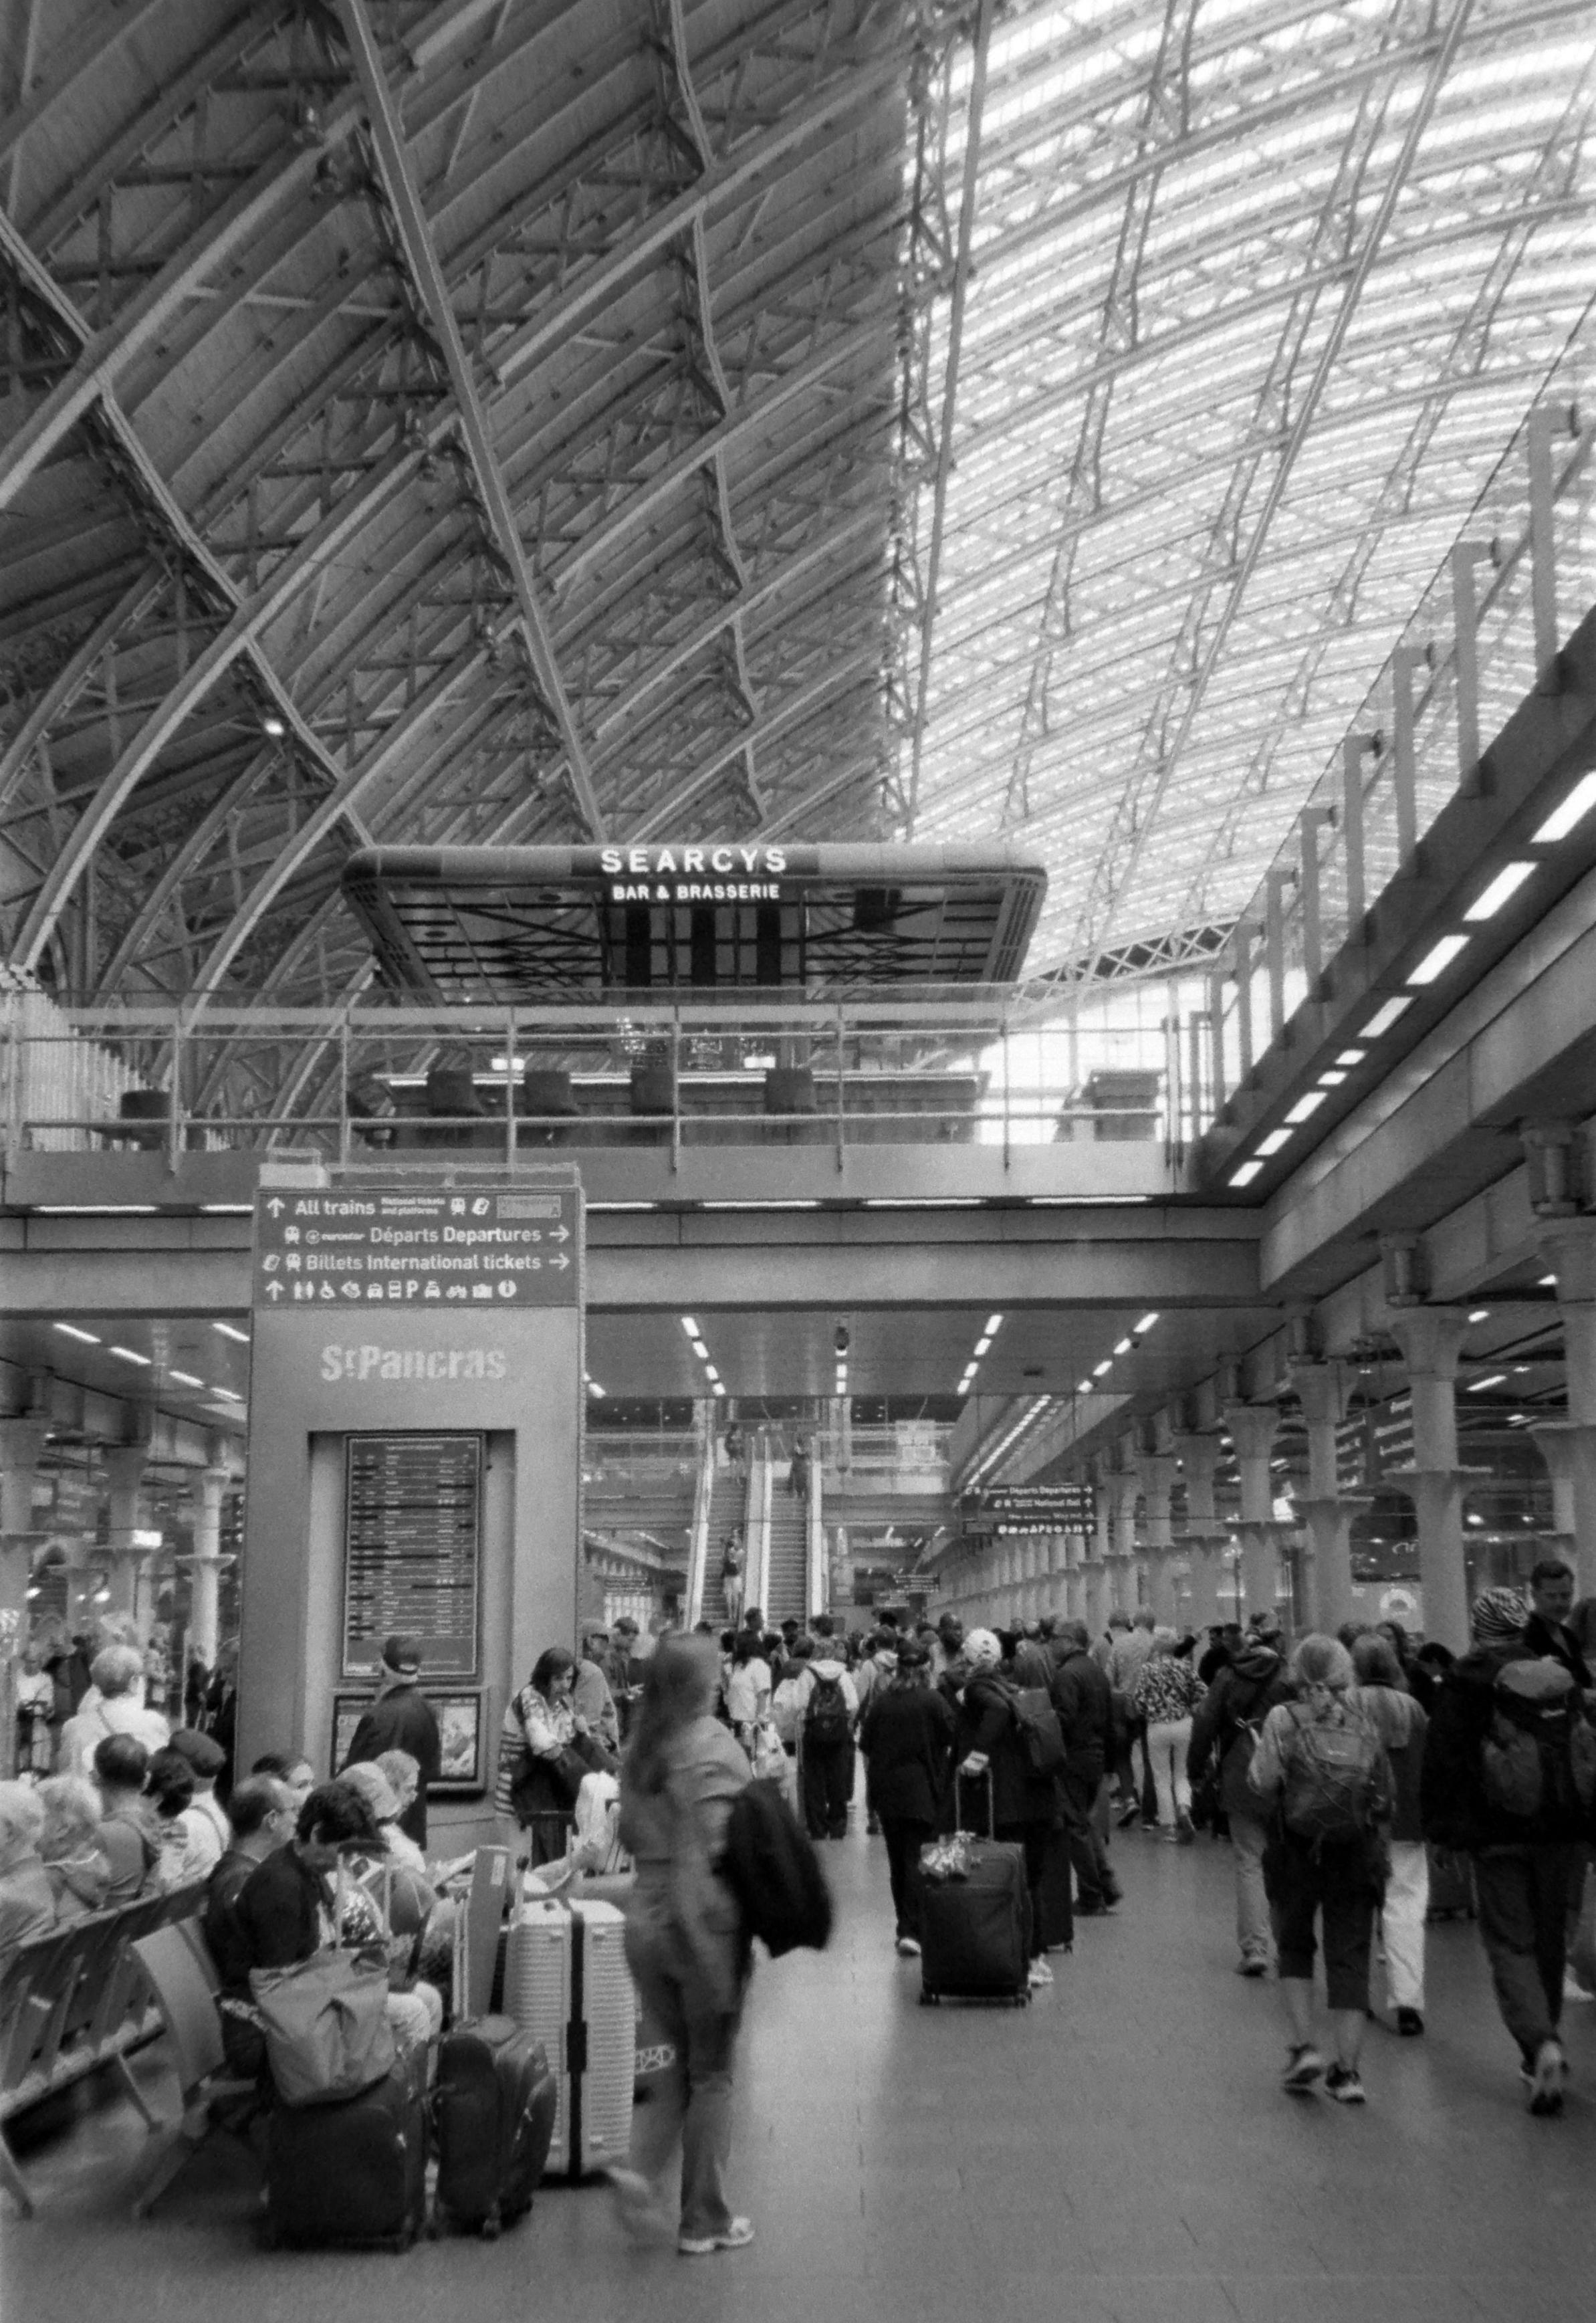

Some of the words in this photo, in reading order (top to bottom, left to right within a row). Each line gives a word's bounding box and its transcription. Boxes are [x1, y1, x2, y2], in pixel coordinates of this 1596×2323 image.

[601, 848, 787, 873] SEARCYS
[612, 885, 649, 900] BAR
[657, 885, 670, 899] &
[677, 883, 780, 899] BRASSERIE
[295, 1200, 320, 1215] All
[323, 1200, 376, 1215] trains
[370, 1226, 439, 1246] Départs
[443, 1226, 542, 1246] Departures
[306, 1255, 363, 1270] Billets
[367, 1254, 479, 1270] International
[483, 1253, 542, 1270] tickets
